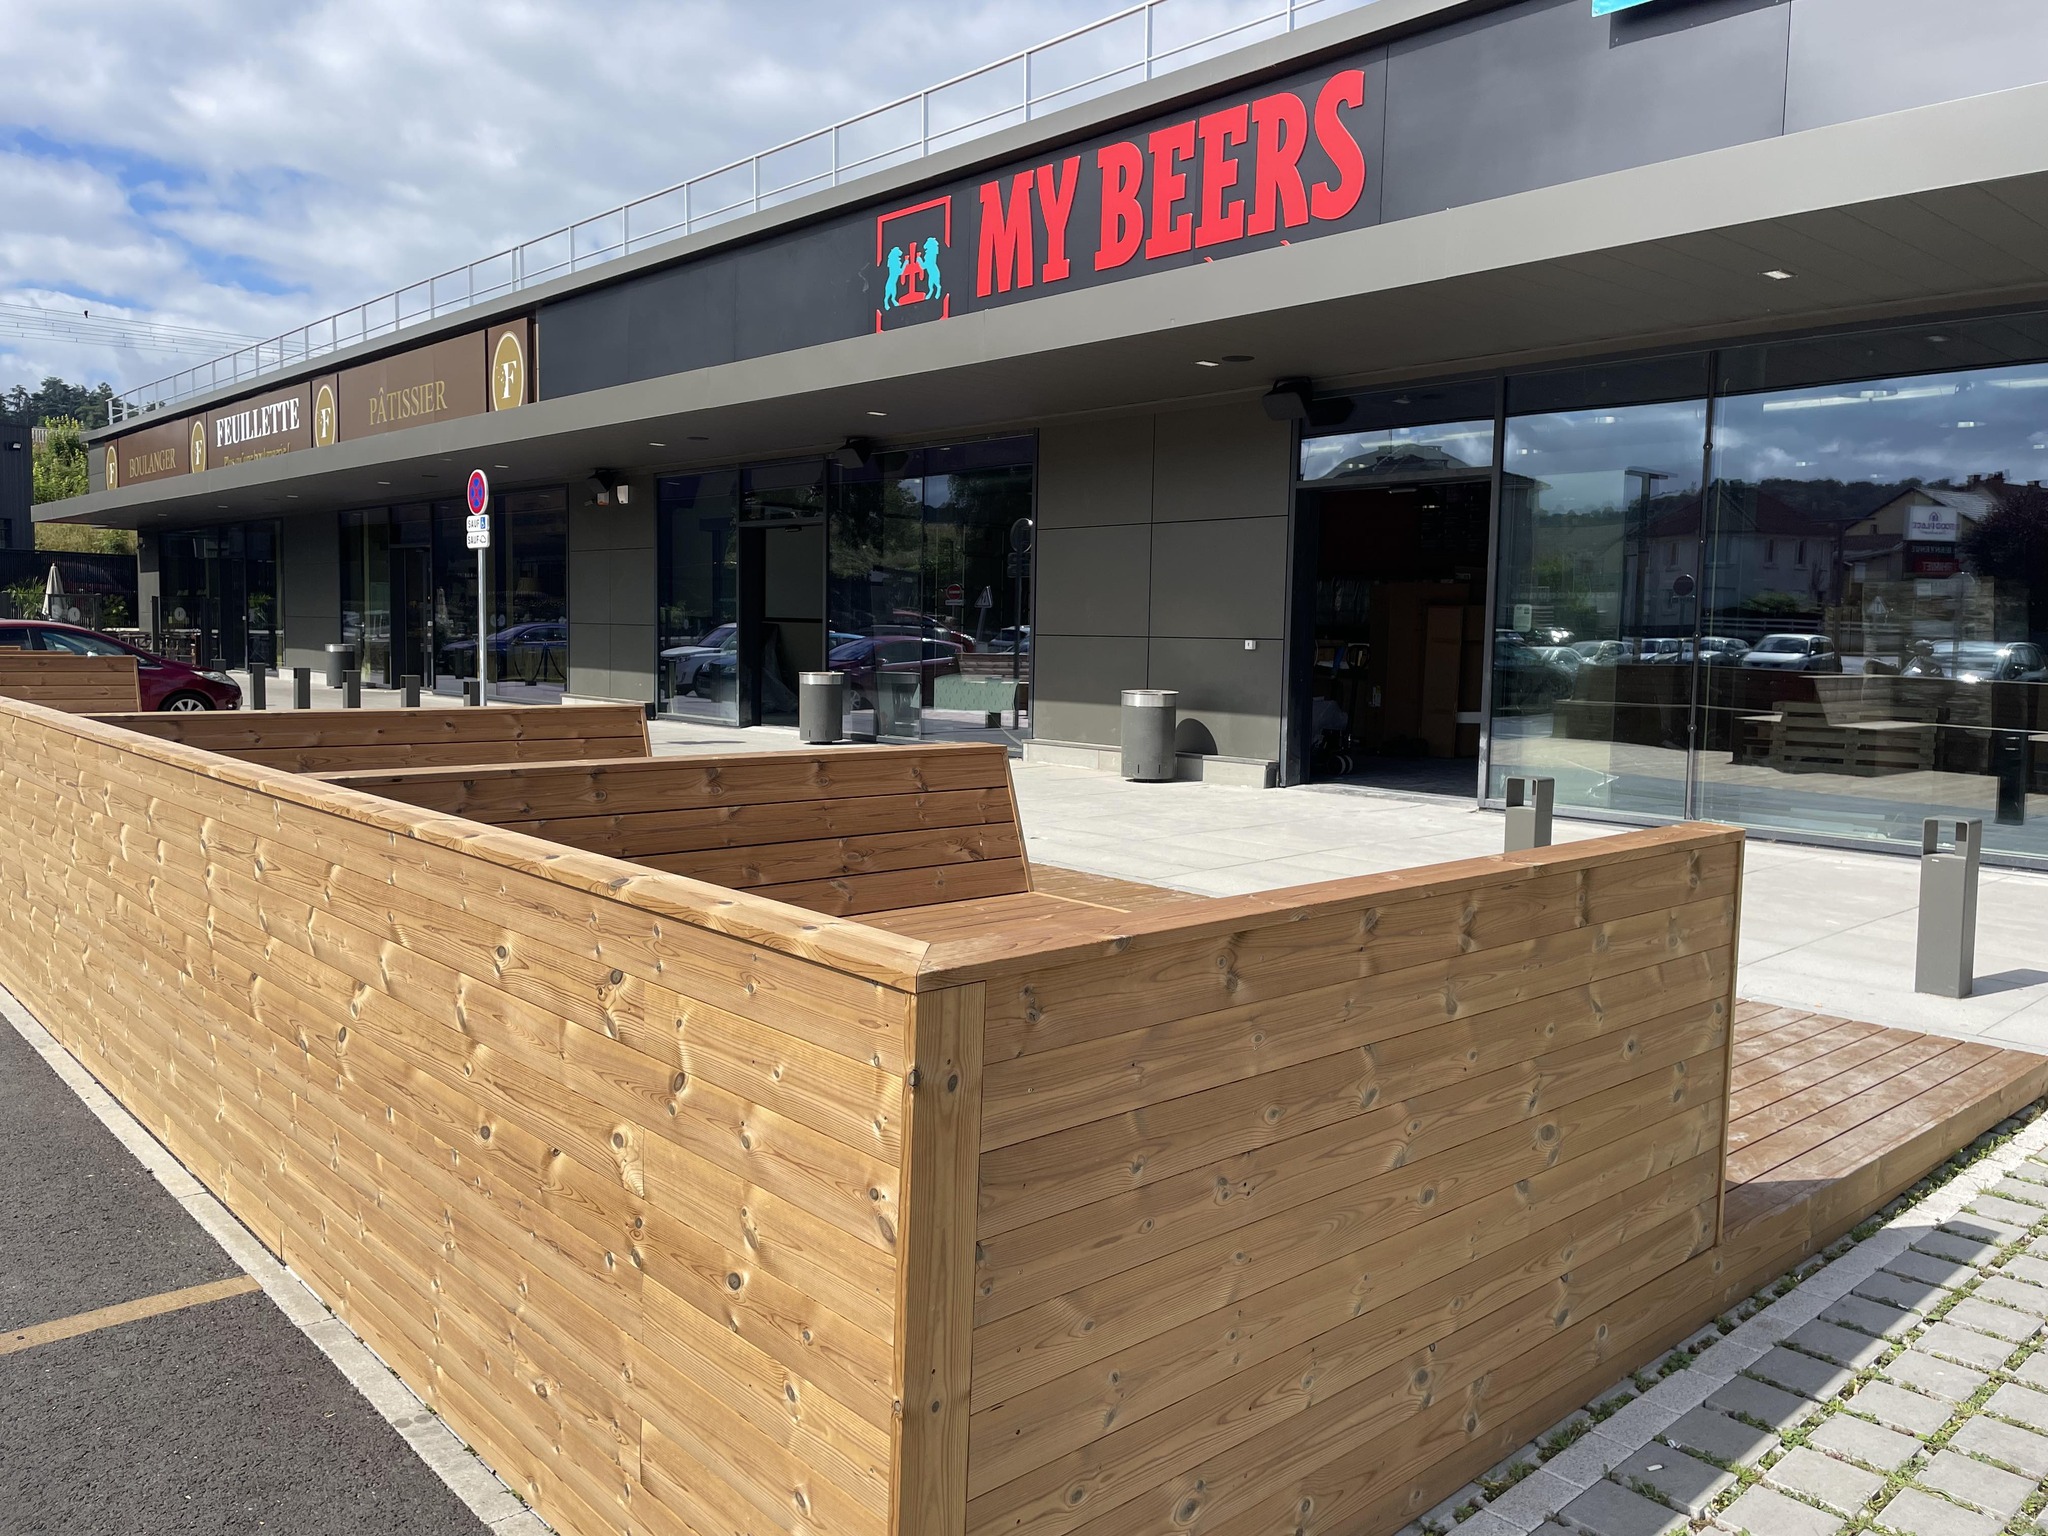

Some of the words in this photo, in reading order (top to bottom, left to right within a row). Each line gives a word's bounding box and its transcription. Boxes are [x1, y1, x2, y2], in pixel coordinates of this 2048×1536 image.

[976, 155, 1081, 298] MY
[1094, 69, 1366, 272] BEERS
[501, 360, 517, 399] F
[369, 380, 448, 426] PÂTISSIER
[216, 397, 300, 448] FEUILLETTE
[320, 407, 331, 438] F
[129, 448, 176, 479] BOULANGER
[194, 439, 203, 465] F
[109, 462, 115, 484] F
[468, 519, 479, 528] SAUF
[468, 535, 479, 544] SAUF
